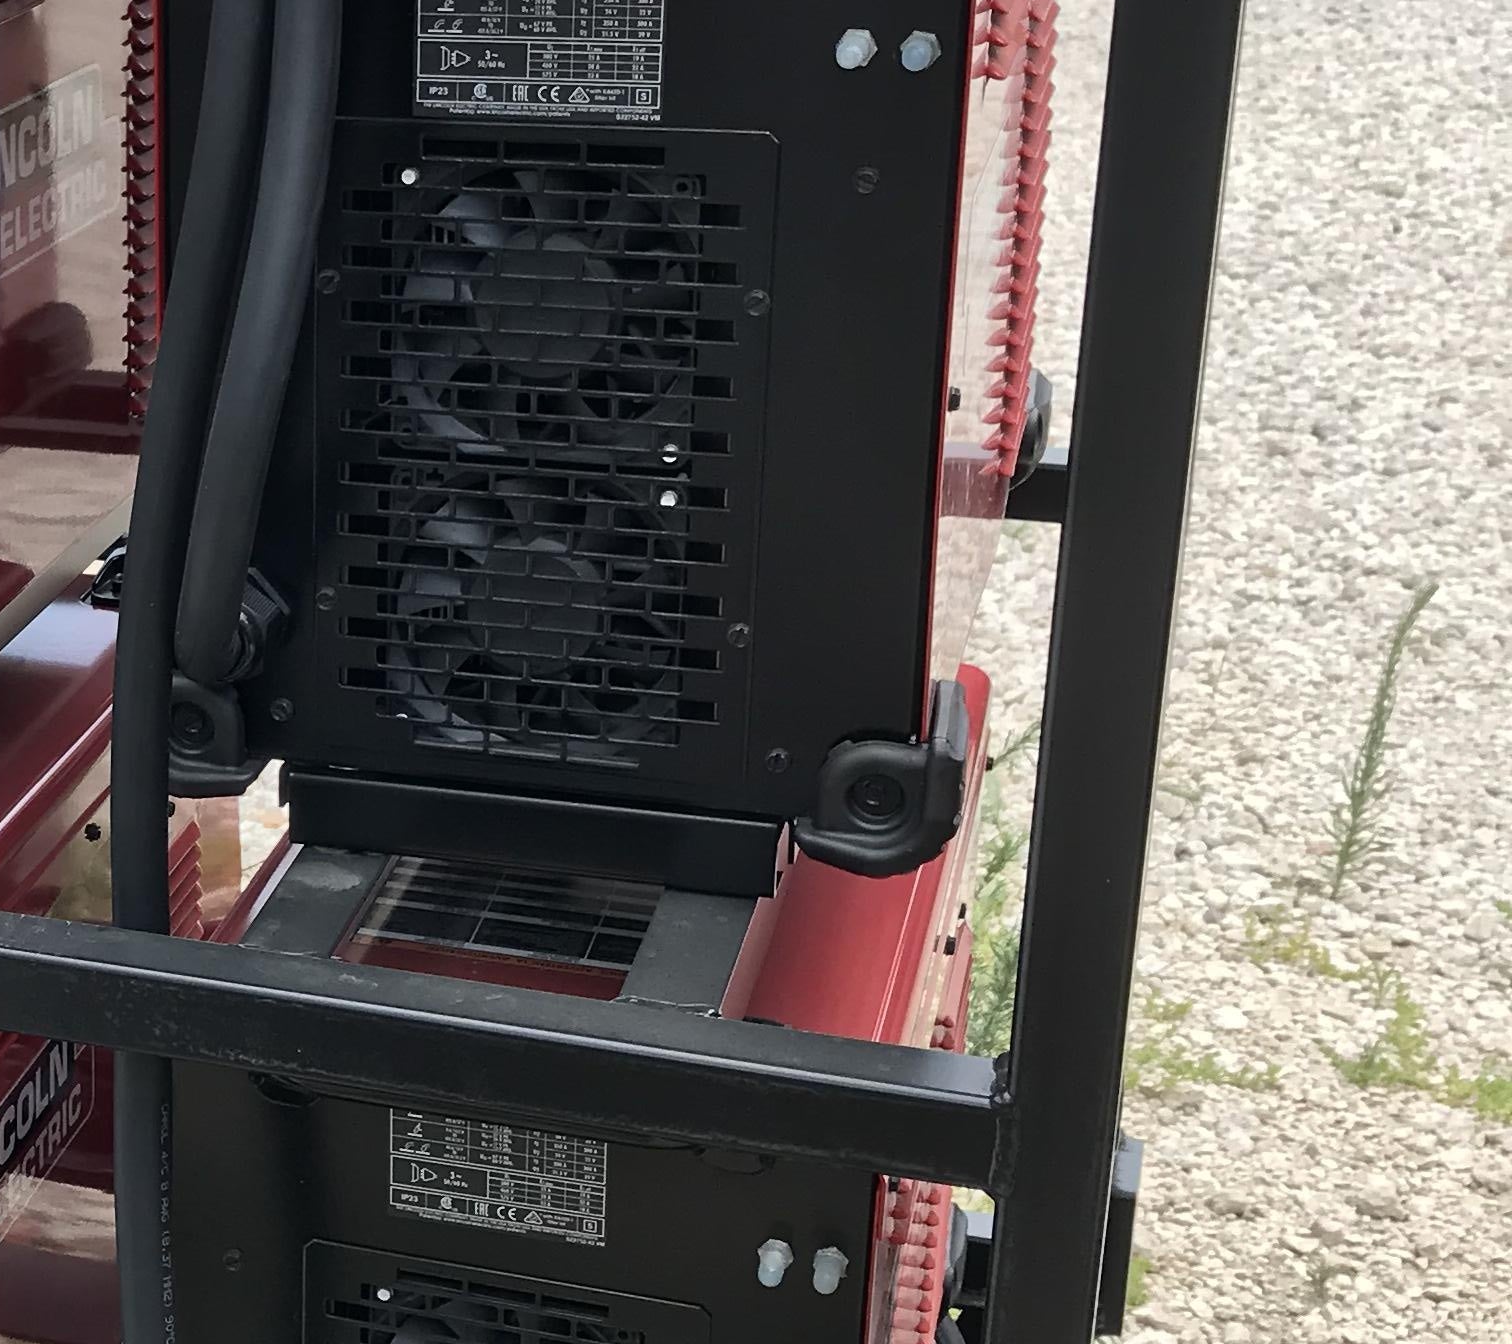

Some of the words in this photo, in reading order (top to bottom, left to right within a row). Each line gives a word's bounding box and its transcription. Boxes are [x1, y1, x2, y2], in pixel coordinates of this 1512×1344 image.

[429, 86, 449, 96] IP23
[0, 159, 106, 260] ELECTRIC
[400, 1192, 419, 1204] IP23
